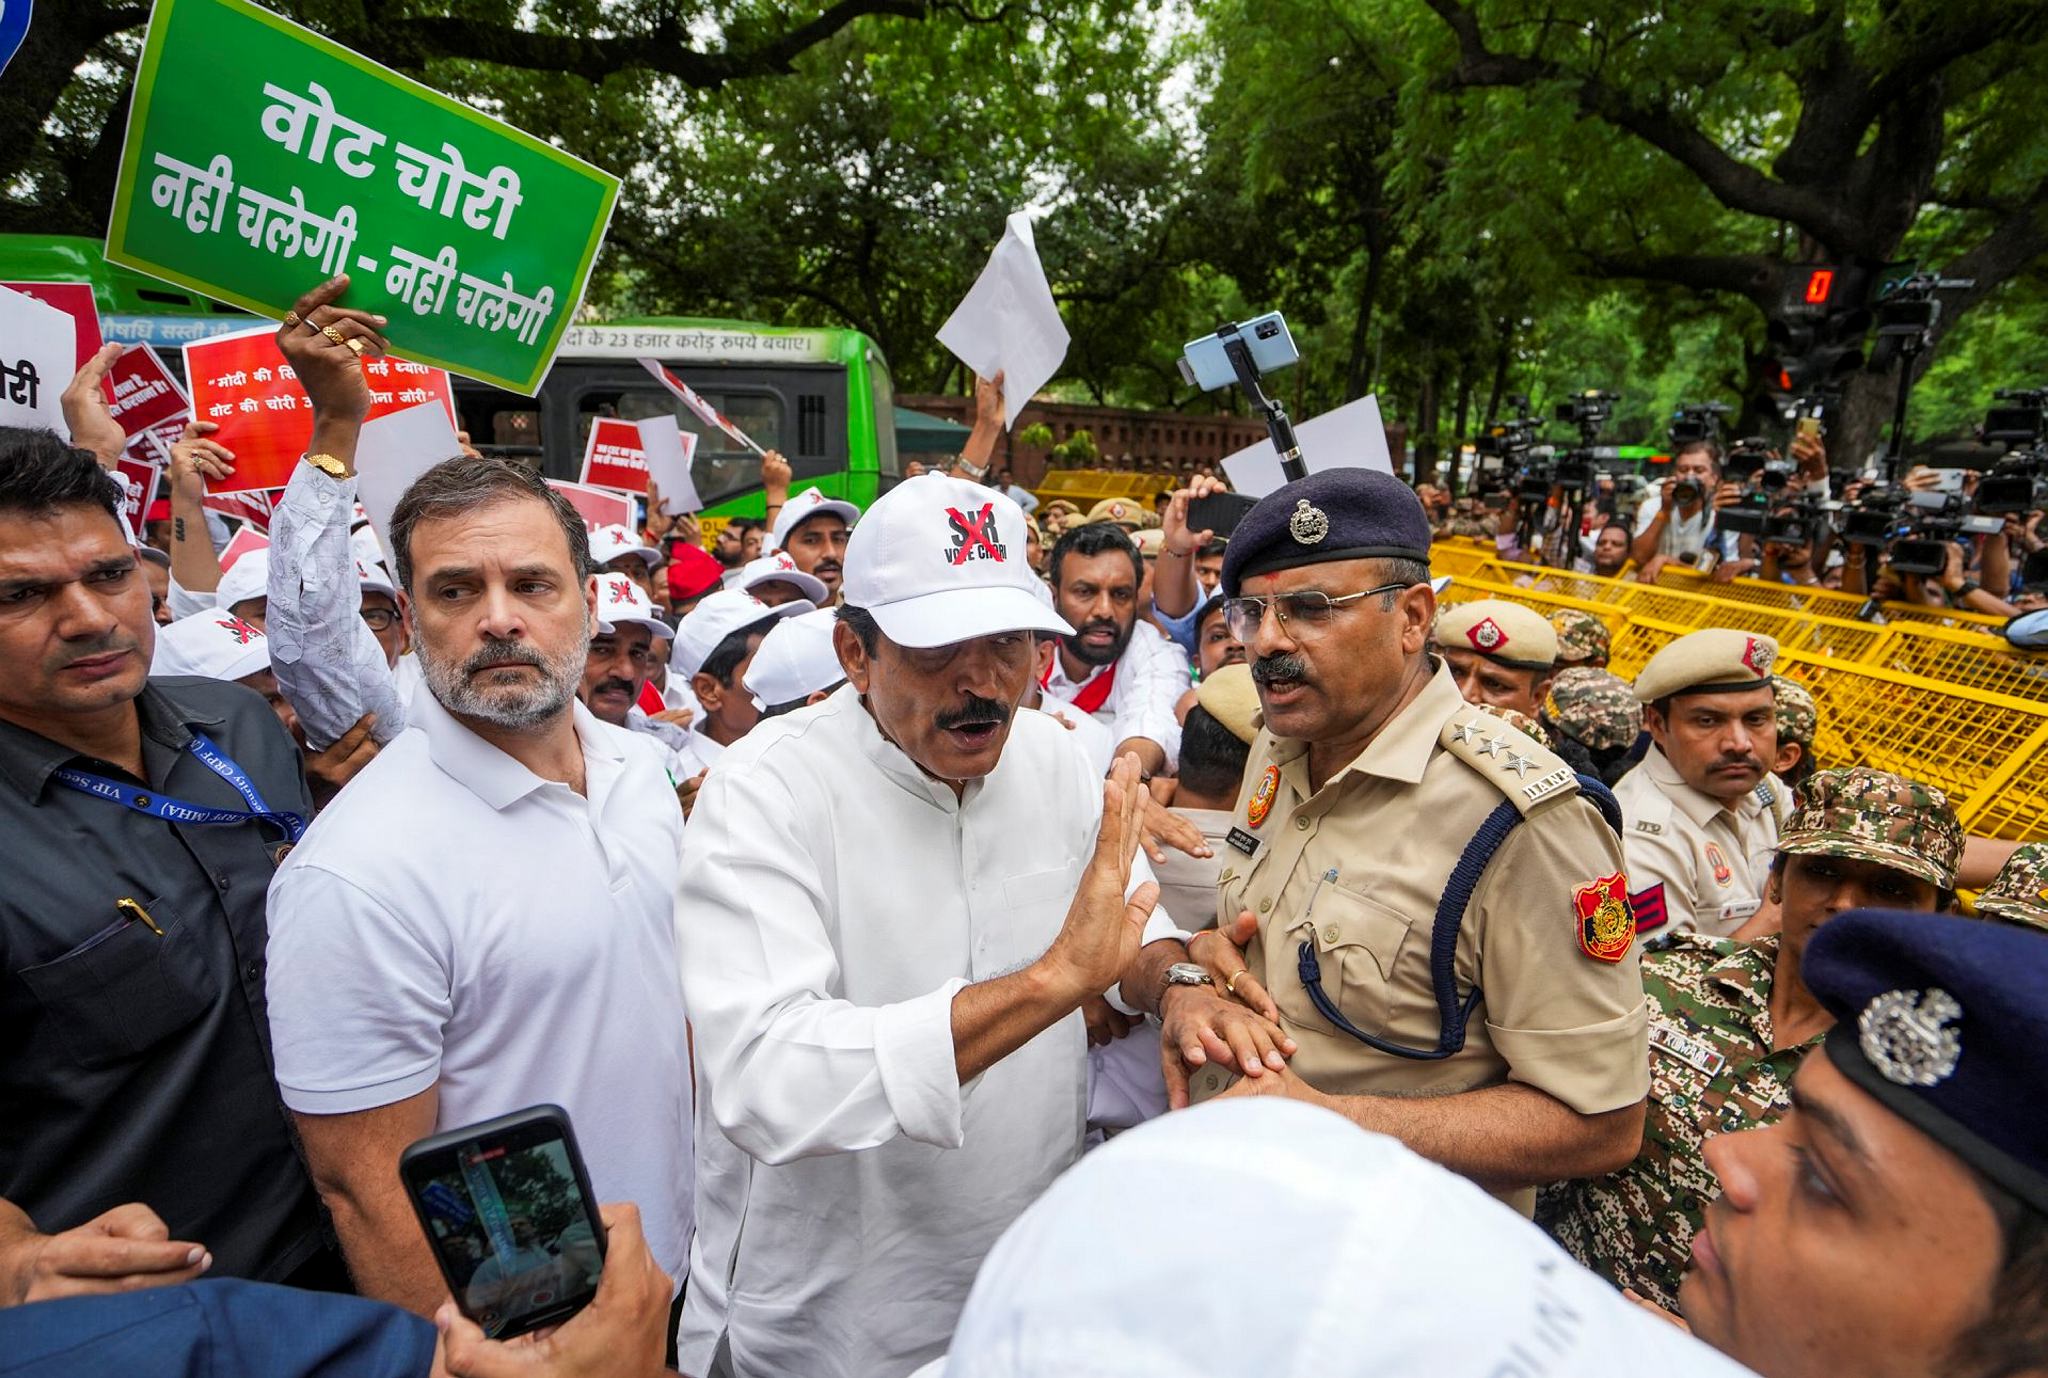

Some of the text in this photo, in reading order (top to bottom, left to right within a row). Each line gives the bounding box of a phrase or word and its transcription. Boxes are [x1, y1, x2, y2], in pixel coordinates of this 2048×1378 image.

[261, 81, 524, 240] वोट चोरी
[237, 185, 358, 277] चलेगी
[456, 271, 555, 346] चलेगी
[588, 328, 606, 346] के
[609, 333, 628, 347] 23
[633, 333, 672, 348] हजार
[675, 330, 716, 353] करोड़
[253, 367, 272, 382] की
[367, 360, 389, 377] नई
[209, 403, 233, 417] वोट
[239, 397, 259, 413] की
[265, 394, 296, 411] चोरी
[944, 548, 975, 563] VOE
[92, 782, 121, 800] VIP
[200, 750, 264, 814] ecurity CRPF
